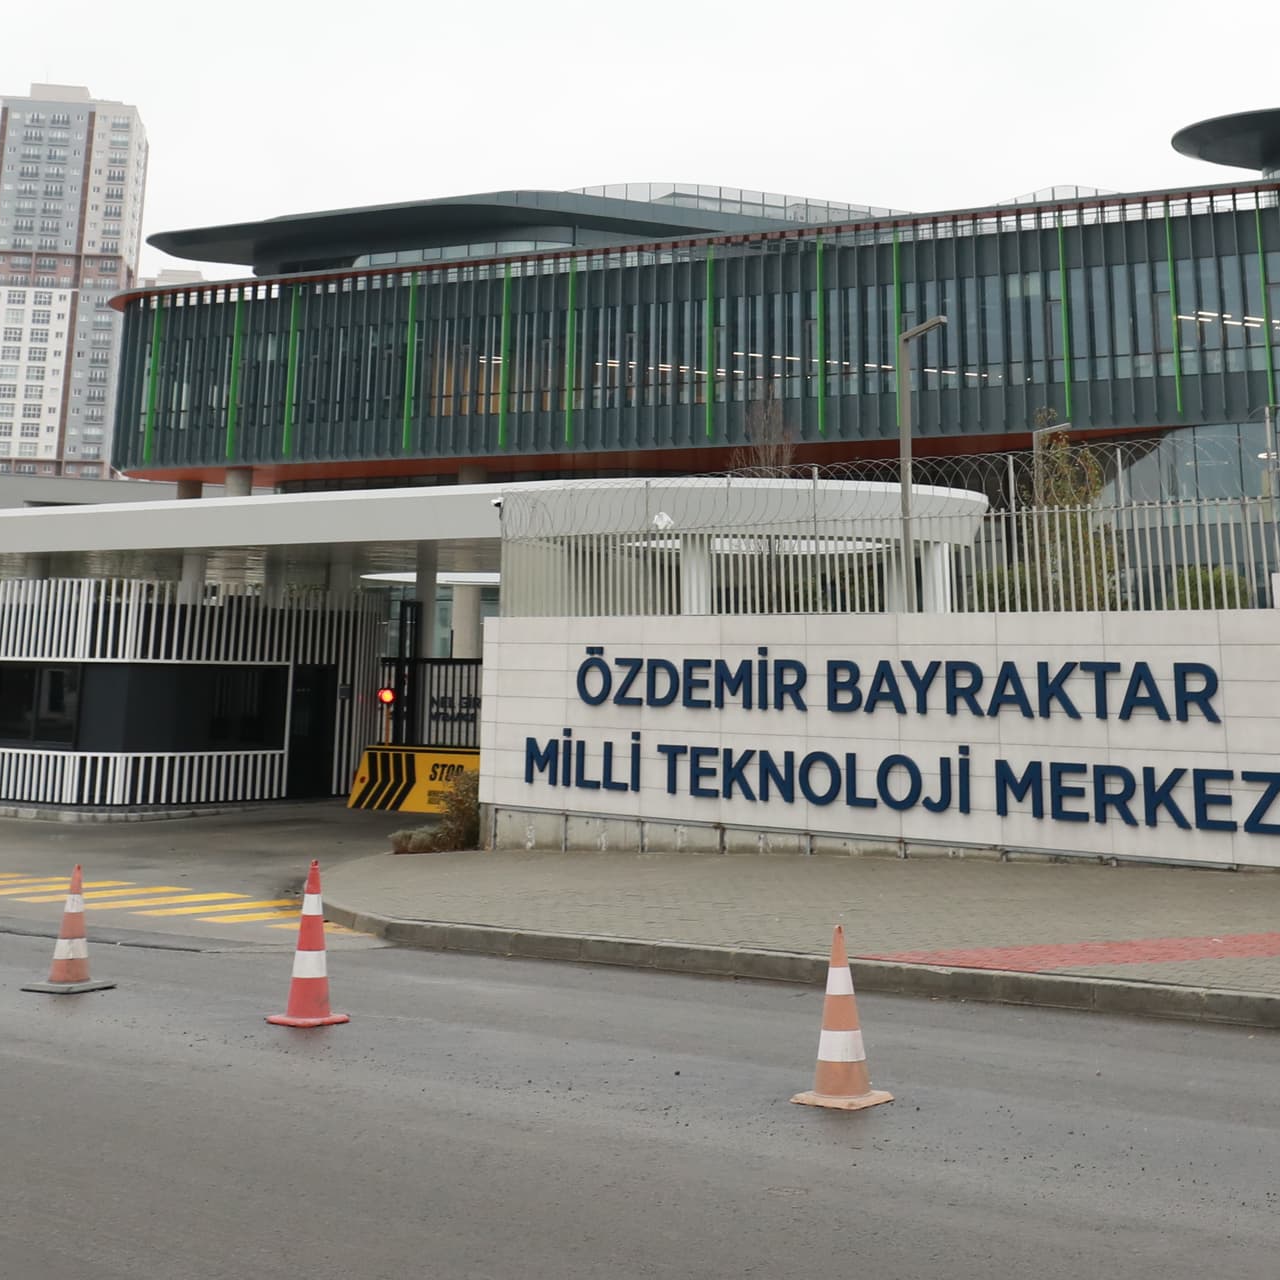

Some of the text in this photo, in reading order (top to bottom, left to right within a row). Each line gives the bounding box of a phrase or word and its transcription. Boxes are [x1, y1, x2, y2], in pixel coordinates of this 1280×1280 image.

[576, 646, 1222, 724] ÖZDEMİR BAYRAKTAR
[524, 728, 641, 793] MİLLİ
[657, 743, 971, 816] TEKNOLOJİ
